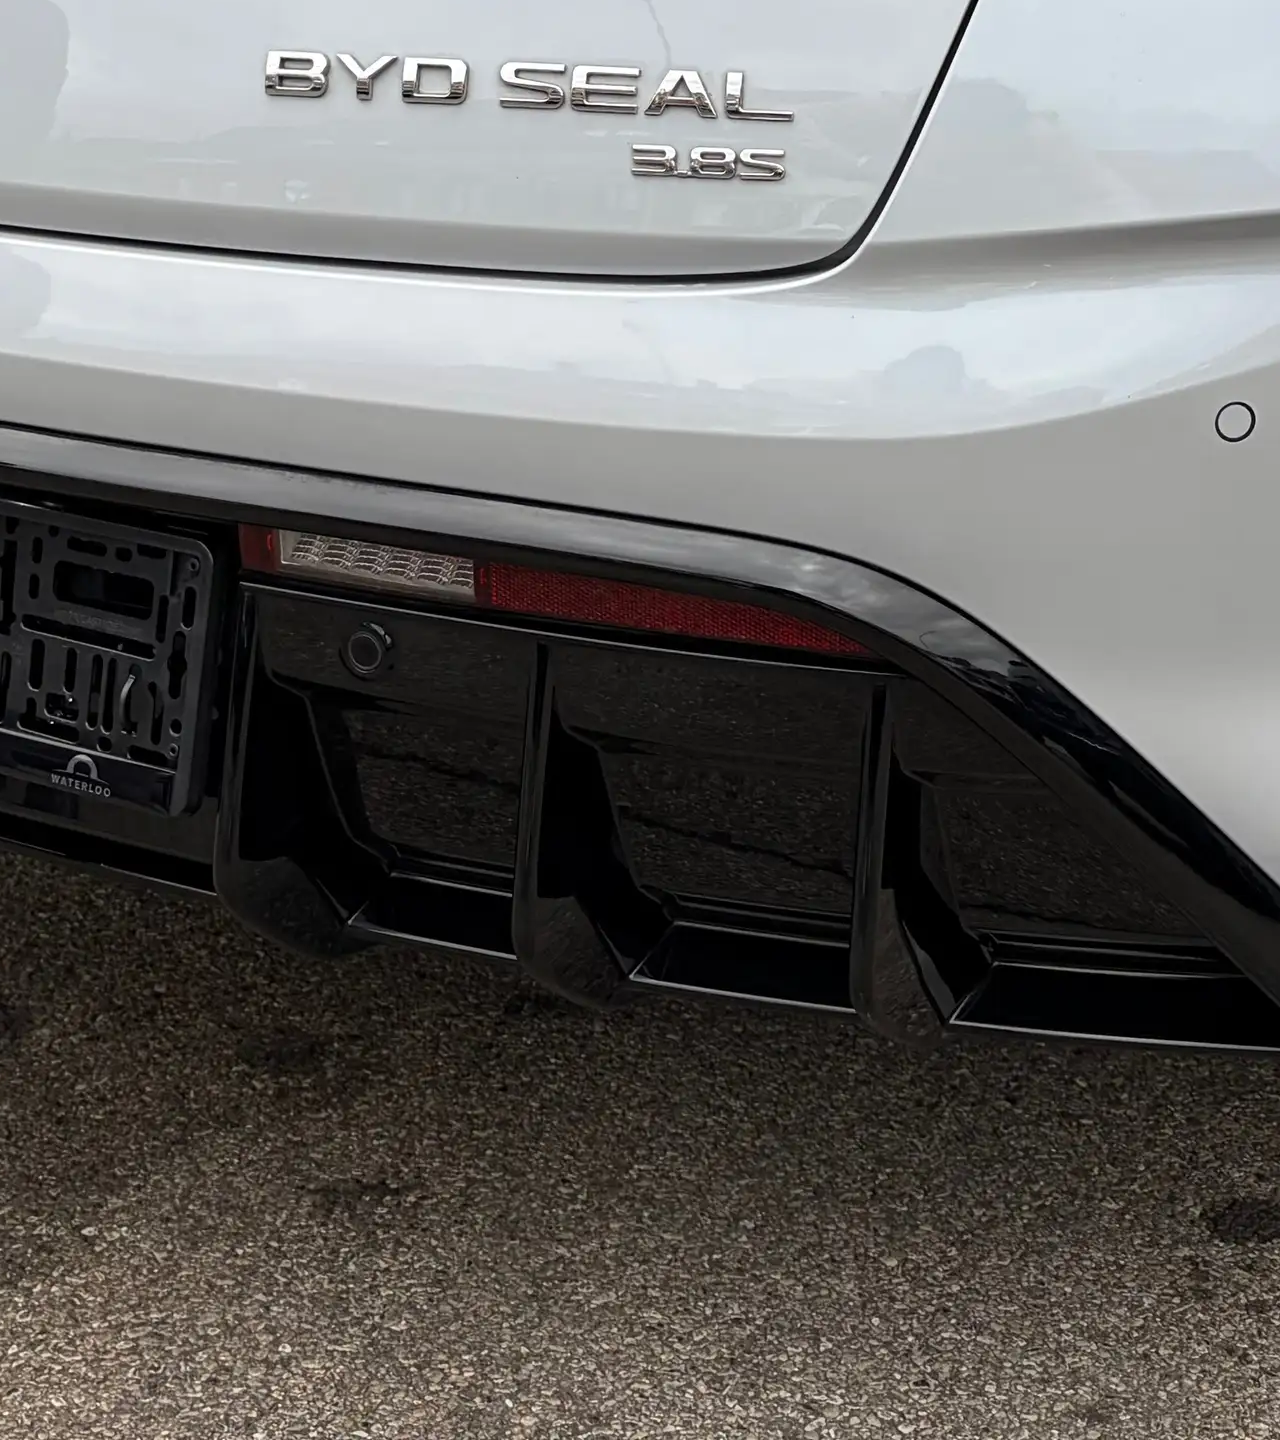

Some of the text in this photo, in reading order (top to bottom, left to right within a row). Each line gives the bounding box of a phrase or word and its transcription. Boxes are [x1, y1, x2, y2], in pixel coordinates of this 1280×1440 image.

[264, 49, 795, 122] BYD SEAL
[630, 143, 787, 182] 3.8S
[50, 772, 111, 798] WATERLOO
